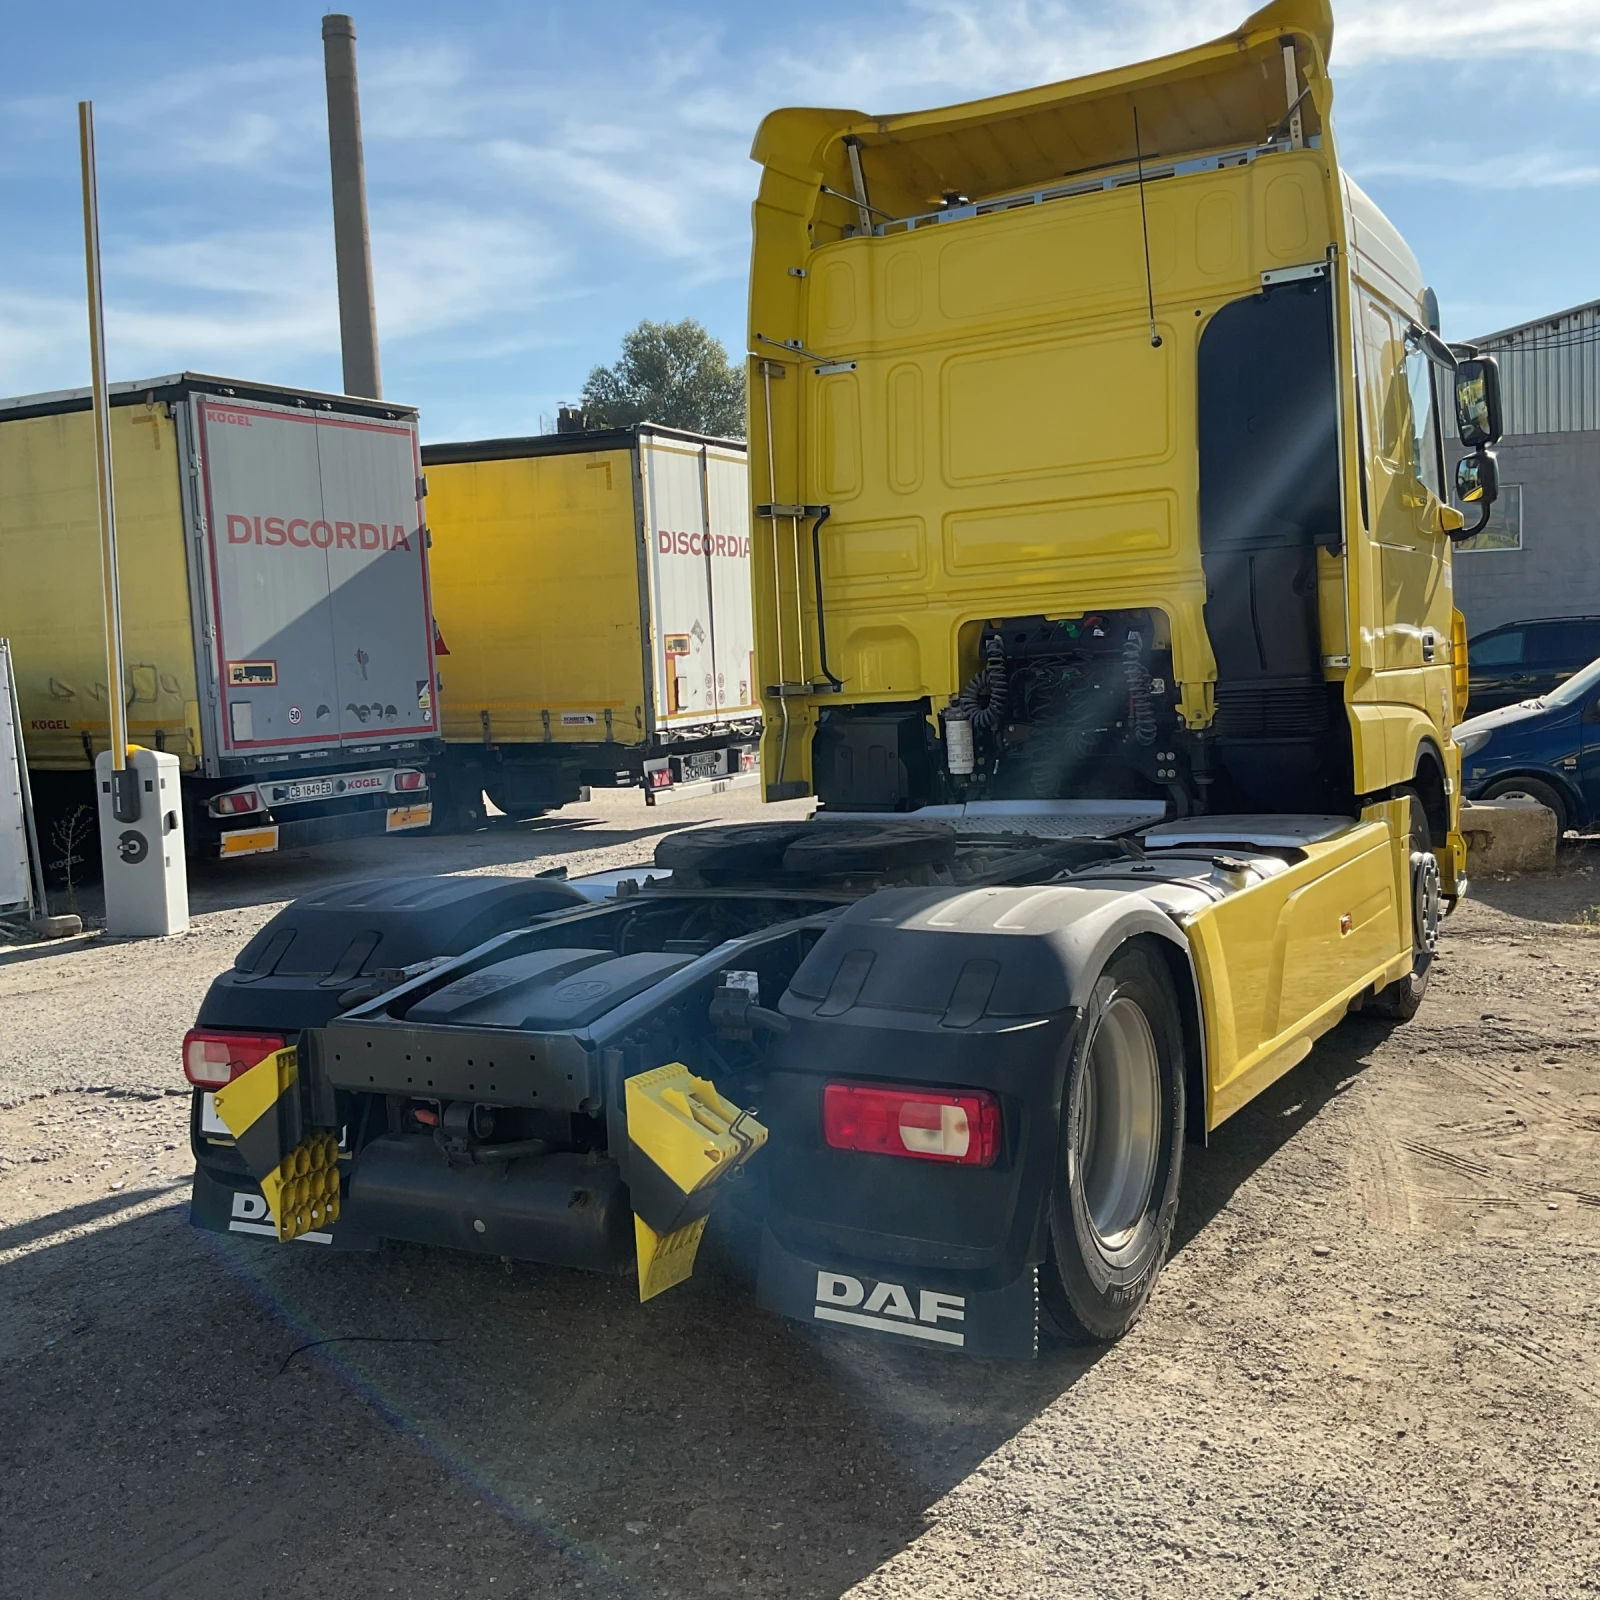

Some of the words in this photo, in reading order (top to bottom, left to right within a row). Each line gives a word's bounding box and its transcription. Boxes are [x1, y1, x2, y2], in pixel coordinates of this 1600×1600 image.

[226, 514, 411, 551] DISCORDIA
[658, 530, 751, 558] DISCORDIA
[290, 710, 300, 720] 50
[685, 765, 717, 780] SCHMITZ
[290, 786, 301, 797] CB
[302, 784, 320, 796] 1849
[321, 783, 332, 794] EB
[816, 1270, 965, 1323] DAF
